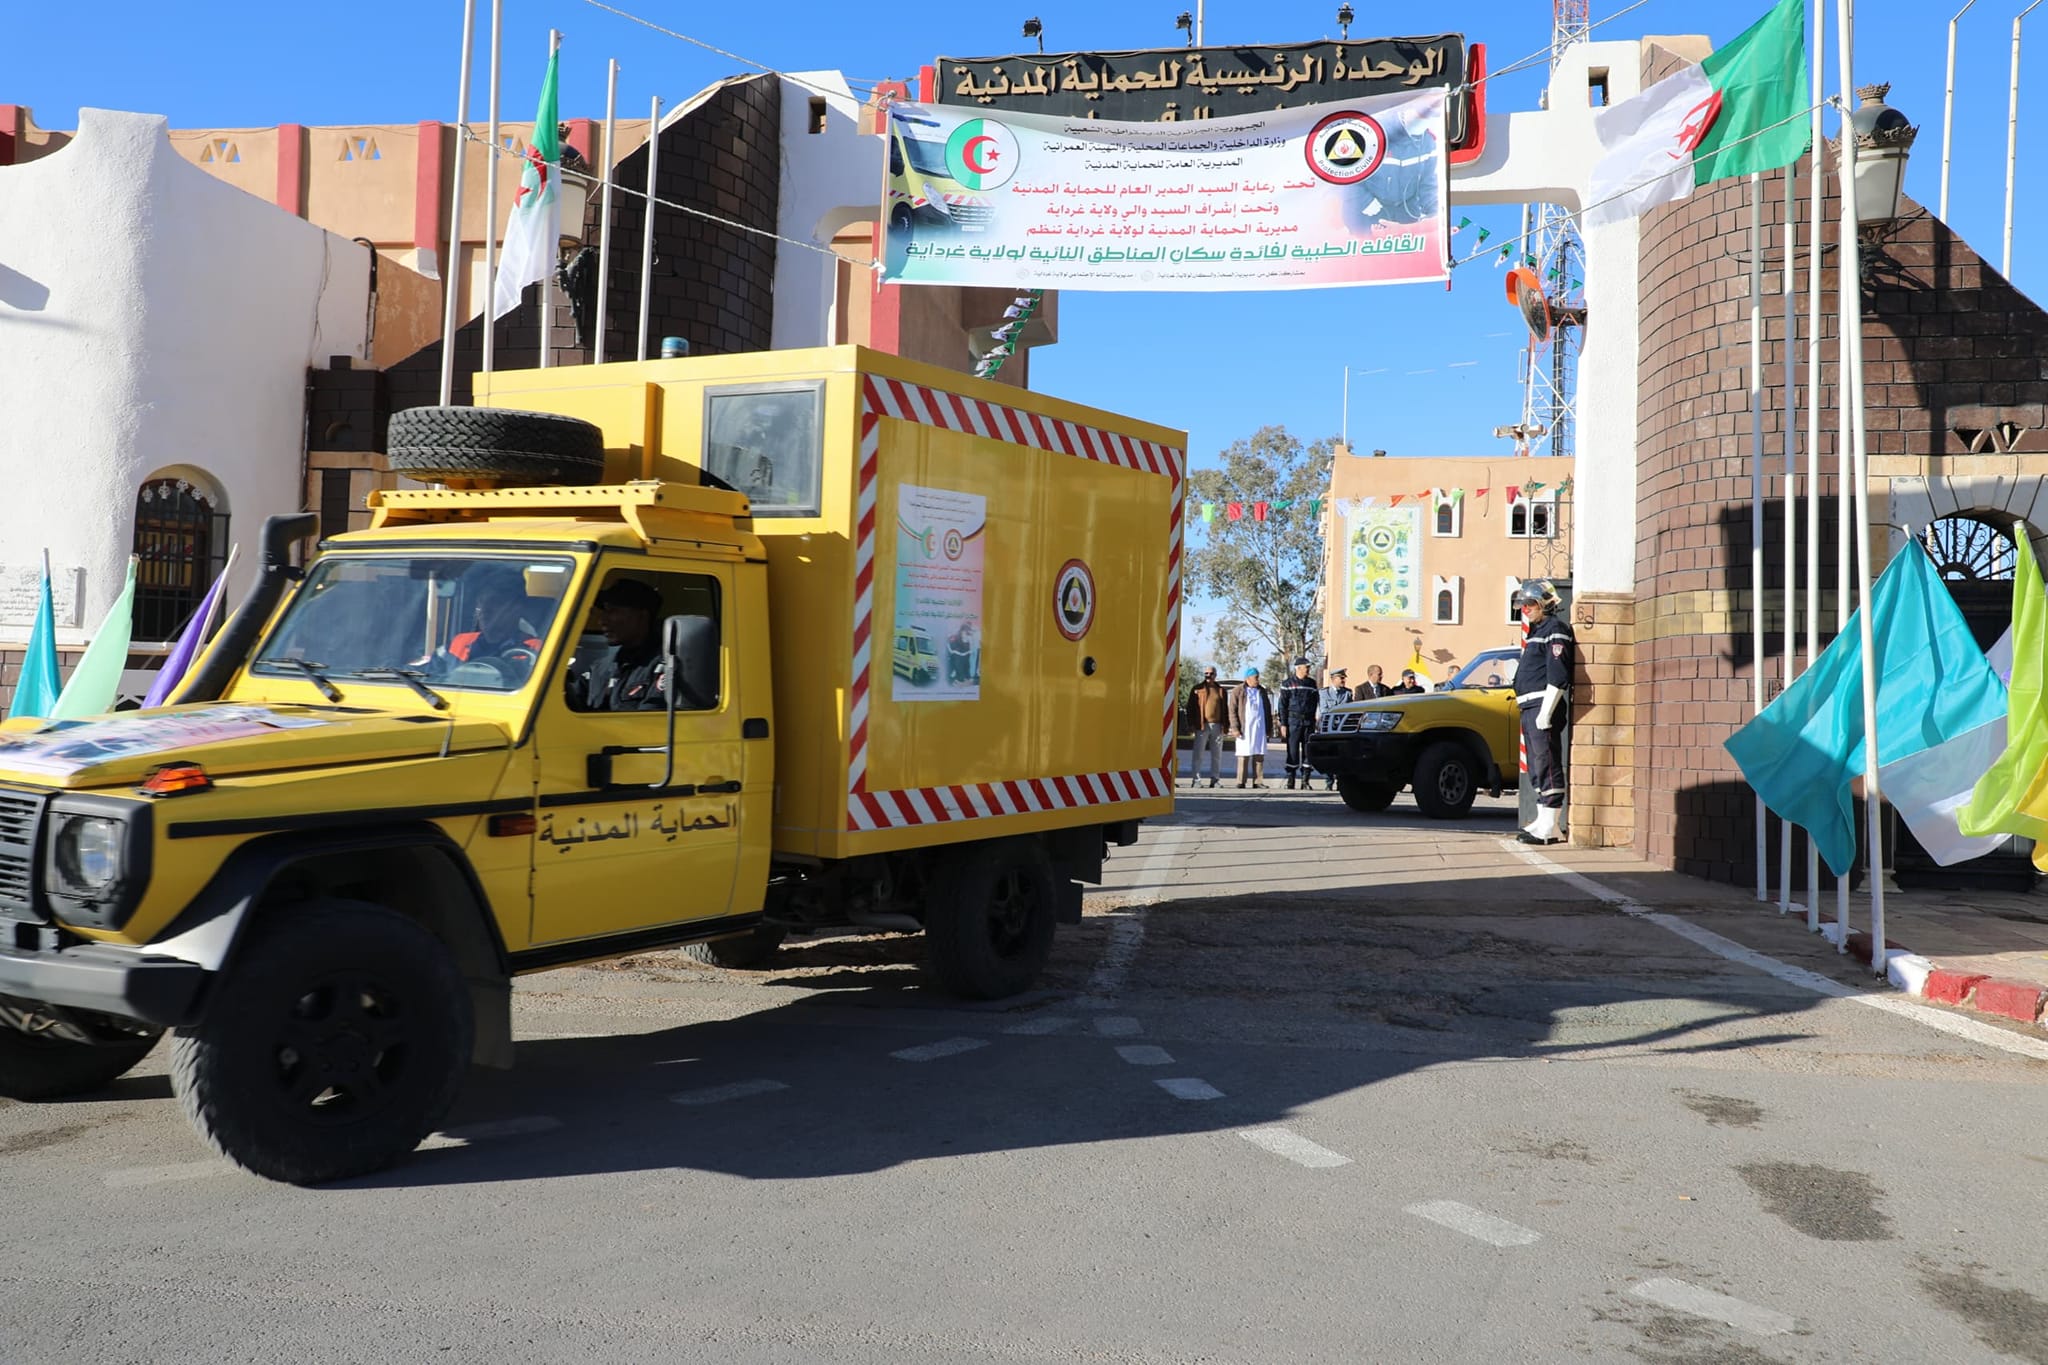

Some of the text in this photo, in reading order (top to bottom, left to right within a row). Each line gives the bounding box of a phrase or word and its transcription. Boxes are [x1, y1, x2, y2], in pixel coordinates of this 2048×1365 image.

[953, 45, 1445, 103] الوحدة الرئيسية للحماية المدنية
[1064, 124, 1103, 134] الشعبية
[1215, 121, 1266, 133] الجمهورية
[1043, 136, 1286, 153] وزارة الداخلية والجماعات المحلية والتهيئة العمرانية
[1085, 157, 1243, 171] المديرية العامة للحماية المدنية
[1318, 156, 1373, 177] Protection Civile
[1012, 177, 1316, 198] تحت رعاية السيد المدير العام للحماية المدنية
[1046, 202, 1279, 221] وتحت إشراف السيد والي ولاية غرداية
[1026, 222, 1298, 238] مديرية الحماية المدنية لولاية غرداية تنظم
[905, 233, 1424, 264] القافلة الطبية لفائدة سكان المناطق النائية لولاية غرداية
[539, 803, 737, 854] الحماية المدنية
